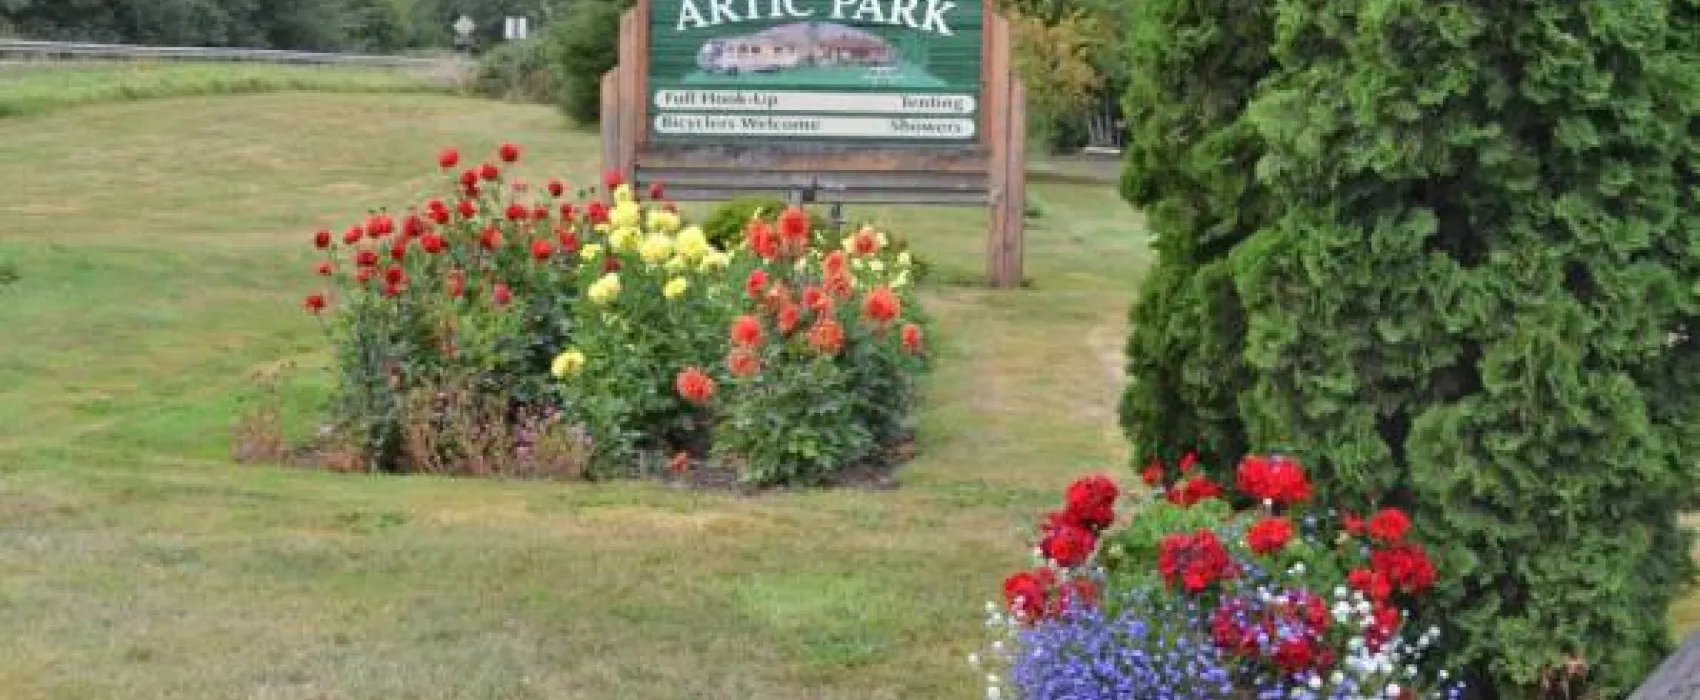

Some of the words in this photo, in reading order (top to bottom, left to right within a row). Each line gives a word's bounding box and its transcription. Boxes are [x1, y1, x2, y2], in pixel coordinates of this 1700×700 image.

[676, 0, 815, 31] ARTIC
[831, 0, 955, 36] PARK
[664, 92, 695, 105] Full
[901, 97, 964, 112] Tenting
[739, 117, 821, 131] Welcome
[889, 119, 961, 134] Showers
